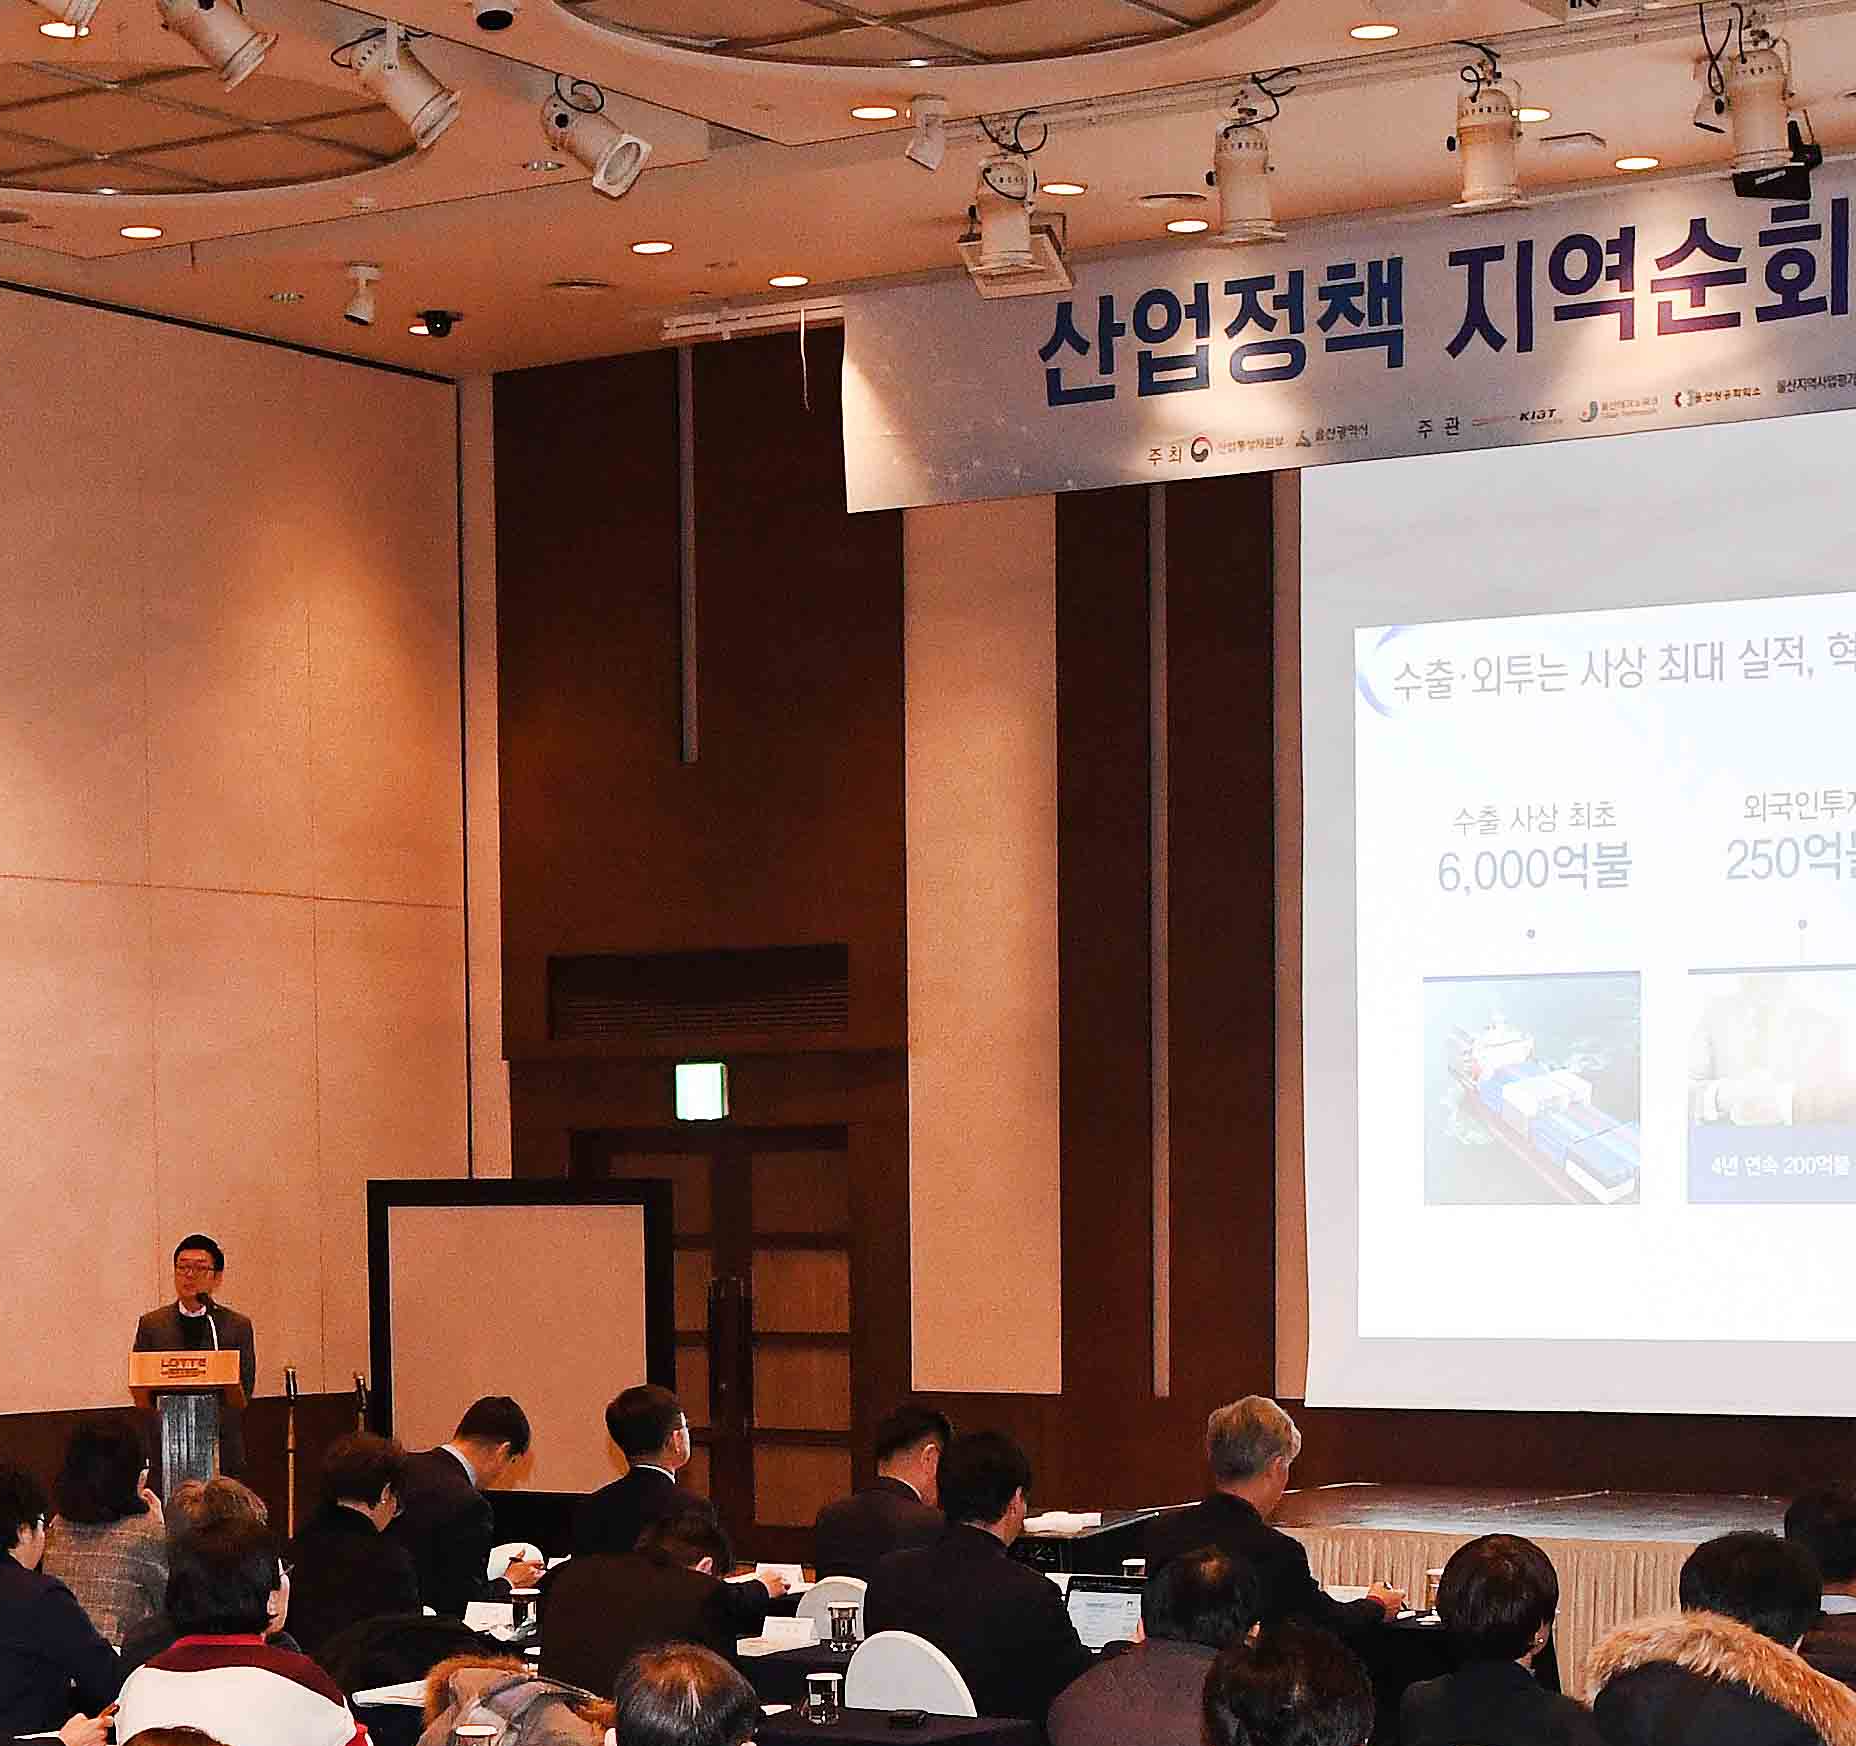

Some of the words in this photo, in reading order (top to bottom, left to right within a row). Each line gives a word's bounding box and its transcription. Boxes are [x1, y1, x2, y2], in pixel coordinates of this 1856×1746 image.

[1038, 255, 1405, 407] 산업정책
[1580, 647, 1647, 689] 사상
[1657, 639, 1727, 685] 최대
[1737, 635, 1815, 681] 실적,
[1451, 803, 1503, 837] 수출
[1509, 802, 1560, 834] 사상
[1568, 800, 1619, 832] 최초
[1436, 840, 1634, 896] 6,000억불
